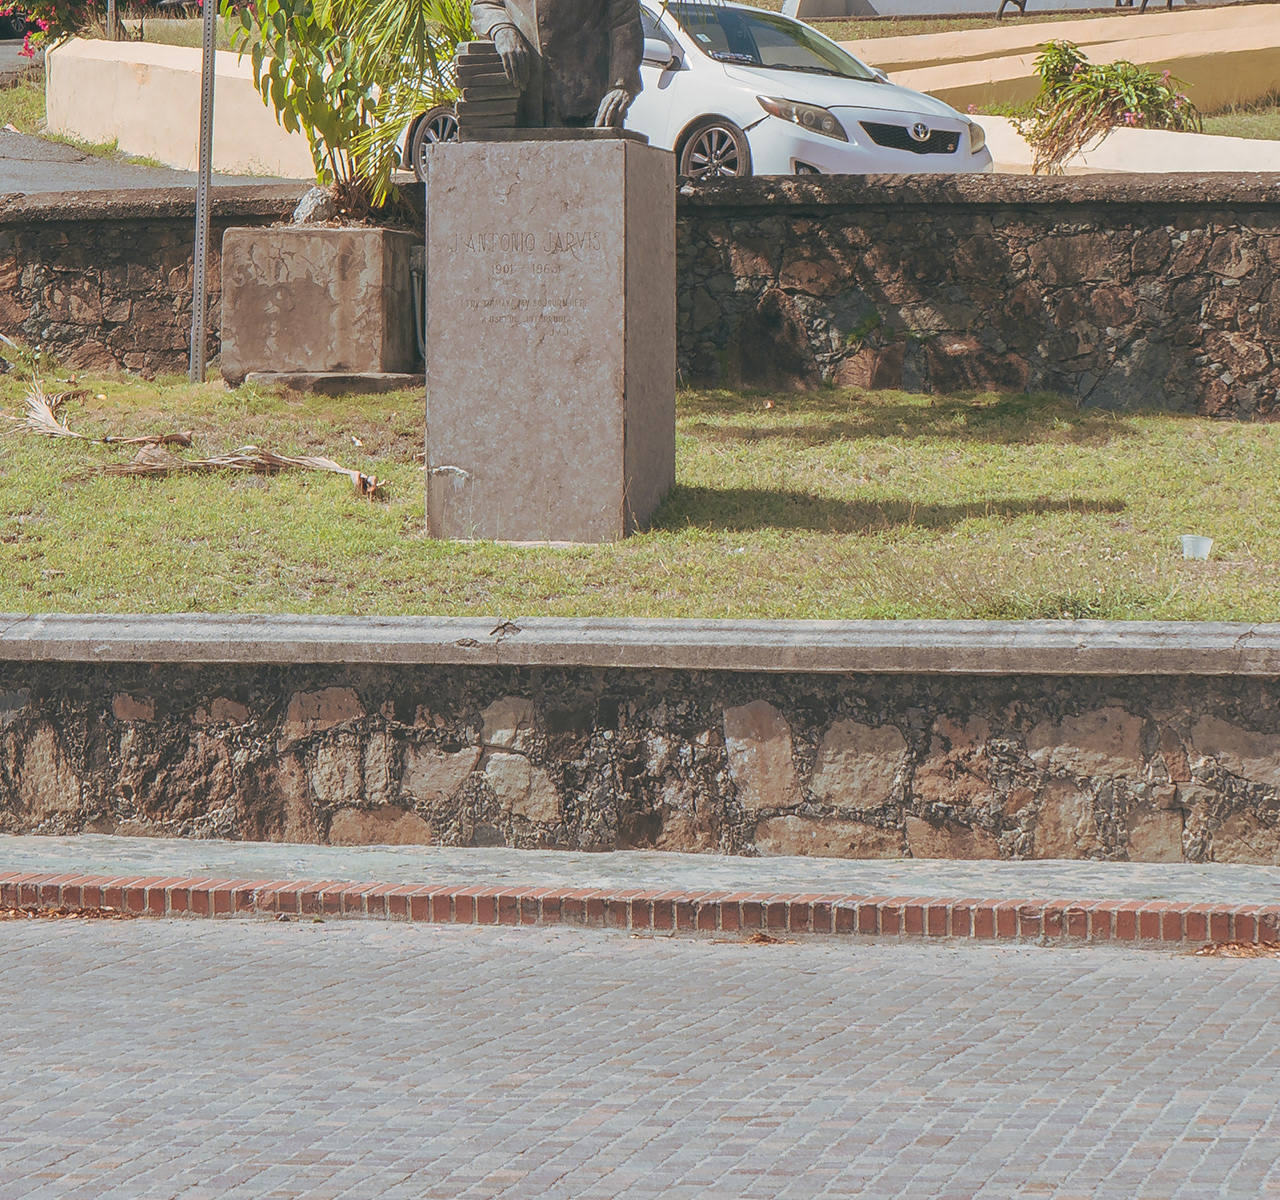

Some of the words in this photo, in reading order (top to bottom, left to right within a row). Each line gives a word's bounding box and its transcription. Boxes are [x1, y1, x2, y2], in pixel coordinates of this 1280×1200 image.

[464, 232, 536, 253] ANTONIO
[544, 232, 601, 261] JARVIS
[491, 263, 514, 275] 1901
